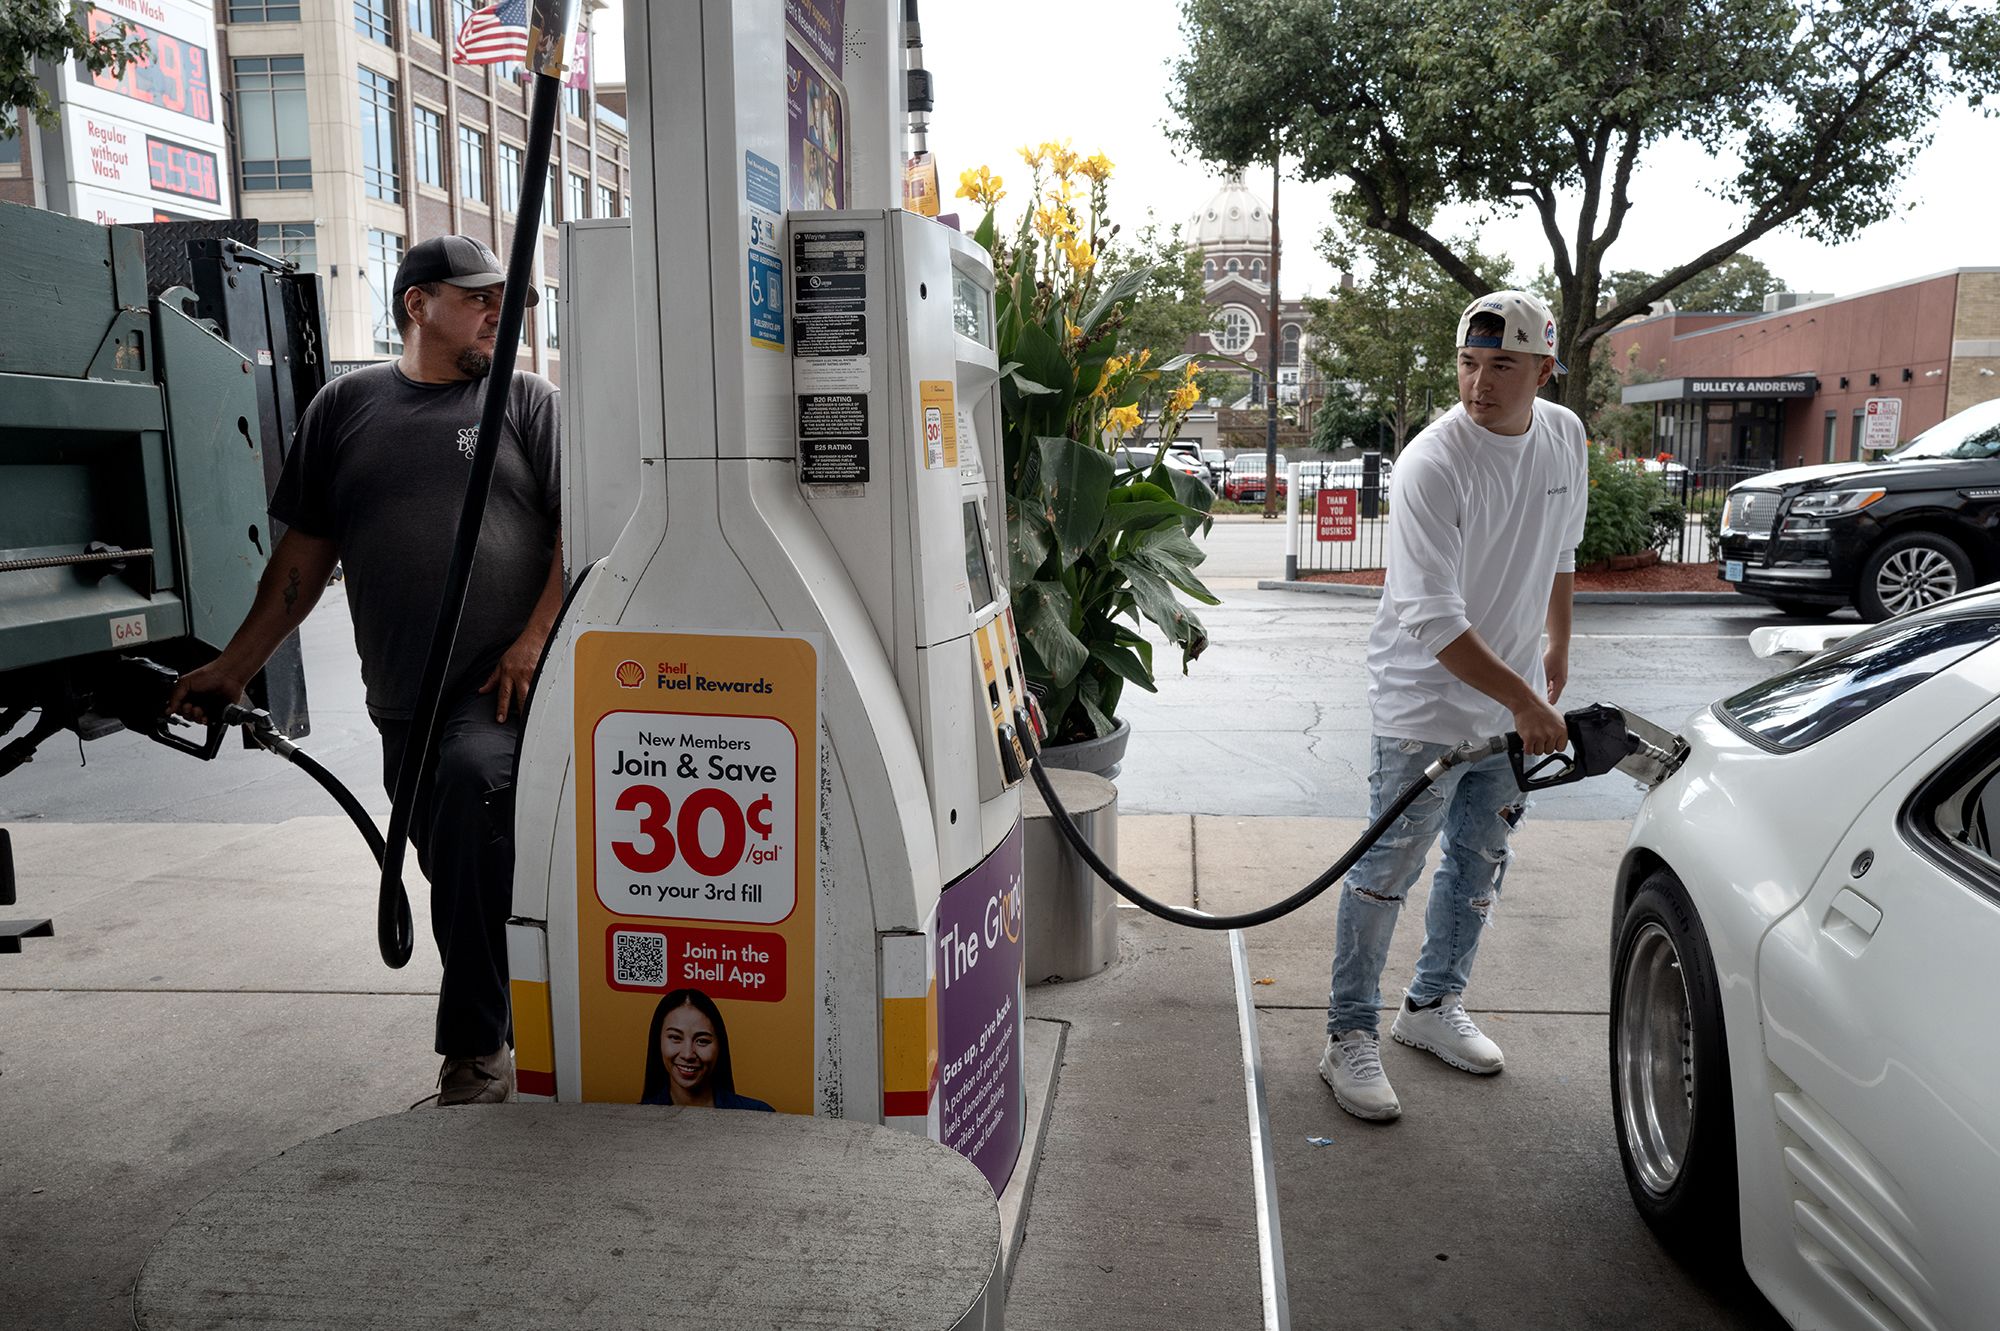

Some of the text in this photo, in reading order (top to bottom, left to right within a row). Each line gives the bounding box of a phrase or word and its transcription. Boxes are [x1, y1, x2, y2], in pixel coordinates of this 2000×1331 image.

[140, 4, 165, 23] Wash
[87, 120, 127, 145] Regular
[91, 145, 129, 166] without
[92, 159, 120, 180] Wash
[97, 210, 118, 224] Plus
[1692, 382, 1805, 392] BULLEY & ANDREWS
[1326, 496, 1348, 504] THANK
[1320, 516, 1353, 525] FOR YOUR
[1330, 506, 1343, 515] YOU
[1321, 527, 1352, 536] BUSINESS
[115, 621, 142, 639] GAS
[658, 662, 687, 674] Shell
[657, 674, 773, 694] Fuel Rewards
[638, 731, 751, 751] New Members
[611, 750, 777, 783] Join & Save
[628, 883, 762, 902] on your 3rd fill
[682, 941, 769, 963] Join in the
[940, 922, 979, 990] The
[683, 962, 766, 988] Shell App
[943, 1060, 963, 1086] Gas
[963, 1042, 979, 1065] up,
[979, 1021, 996, 1053] give
[943, 1099, 950, 1118] A
[950, 1075, 976, 1109] portion
[976, 1060, 983, 1082] of
[982, 1052, 995, 1078] your
[944, 1045, 1010, 1142] fuels donations to local
[950, 1123, 975, 1153] arities
[972, 1127, 985, 1159] and
